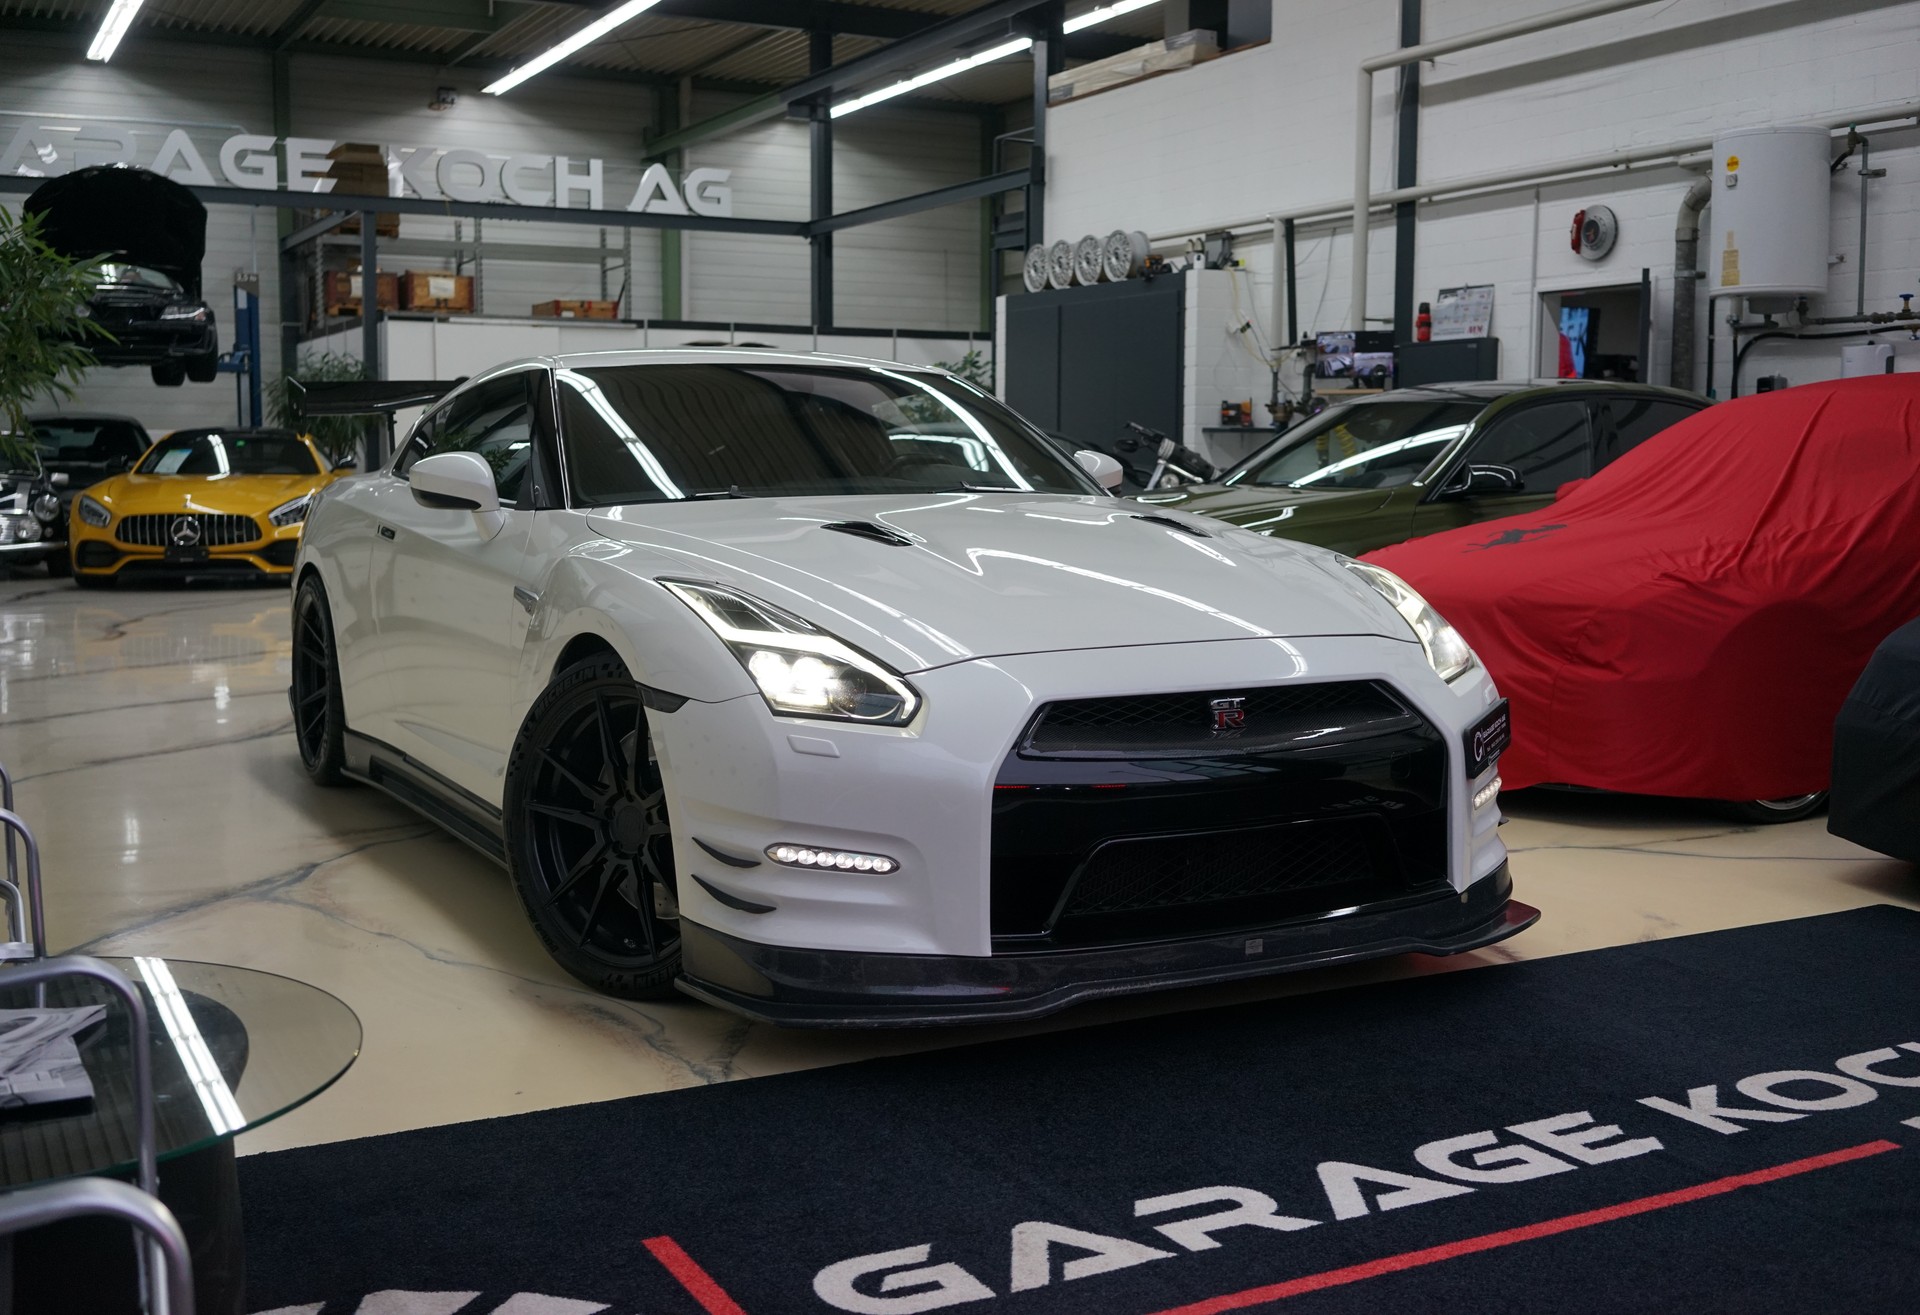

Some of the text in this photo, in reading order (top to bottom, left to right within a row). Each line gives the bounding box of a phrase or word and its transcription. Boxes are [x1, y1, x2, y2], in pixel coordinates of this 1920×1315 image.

[388, 146, 603, 211] KOCH
[627, 162, 732, 217] AG
[530, 663, 597, 722] MICHELIN
[812, 1041, 1920, 1315] GARAGE KOC
